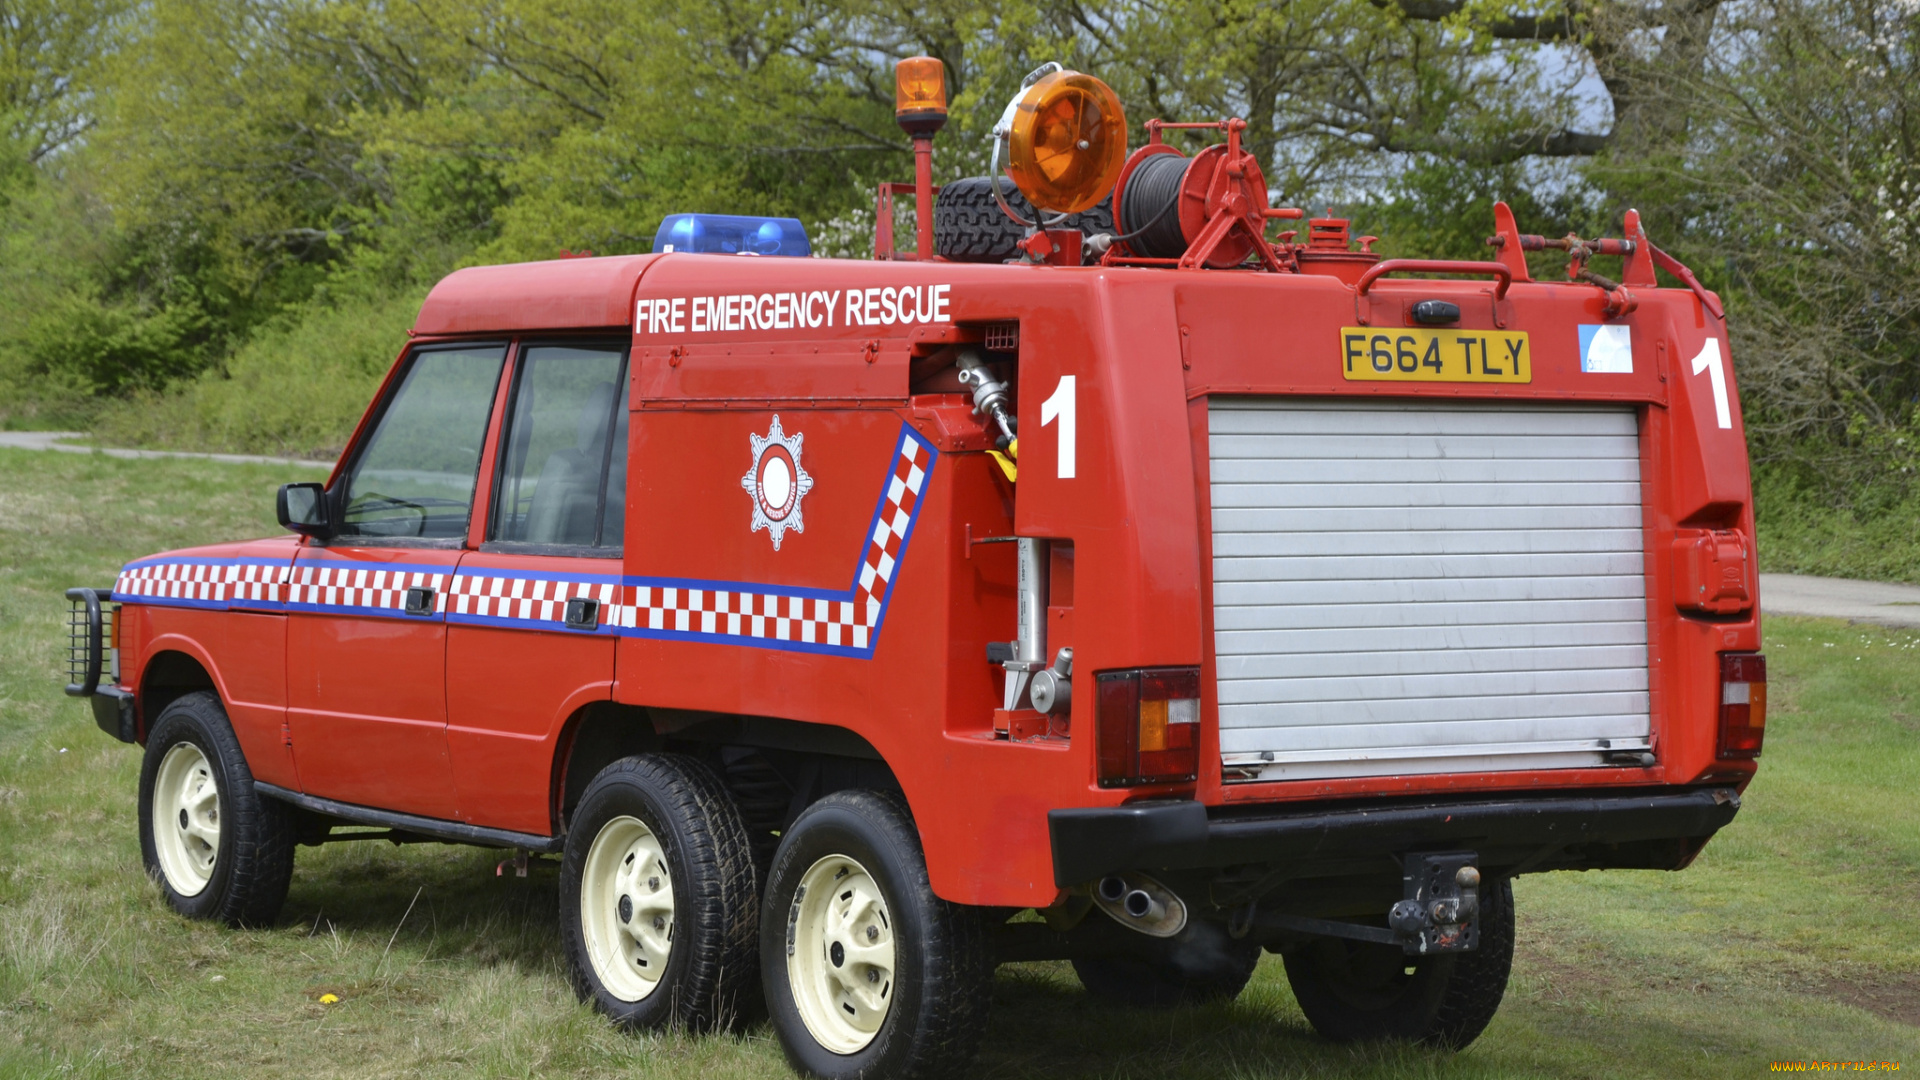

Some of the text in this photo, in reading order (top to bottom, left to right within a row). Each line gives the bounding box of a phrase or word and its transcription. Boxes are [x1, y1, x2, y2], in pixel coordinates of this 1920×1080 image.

[636, 284, 951, 334] FIRE EMERGENCY RESCUE
[1345, 335, 1524, 375] F664 TLY
[1691, 337, 1732, 429] 1
[1041, 375, 1076, 478] 1
